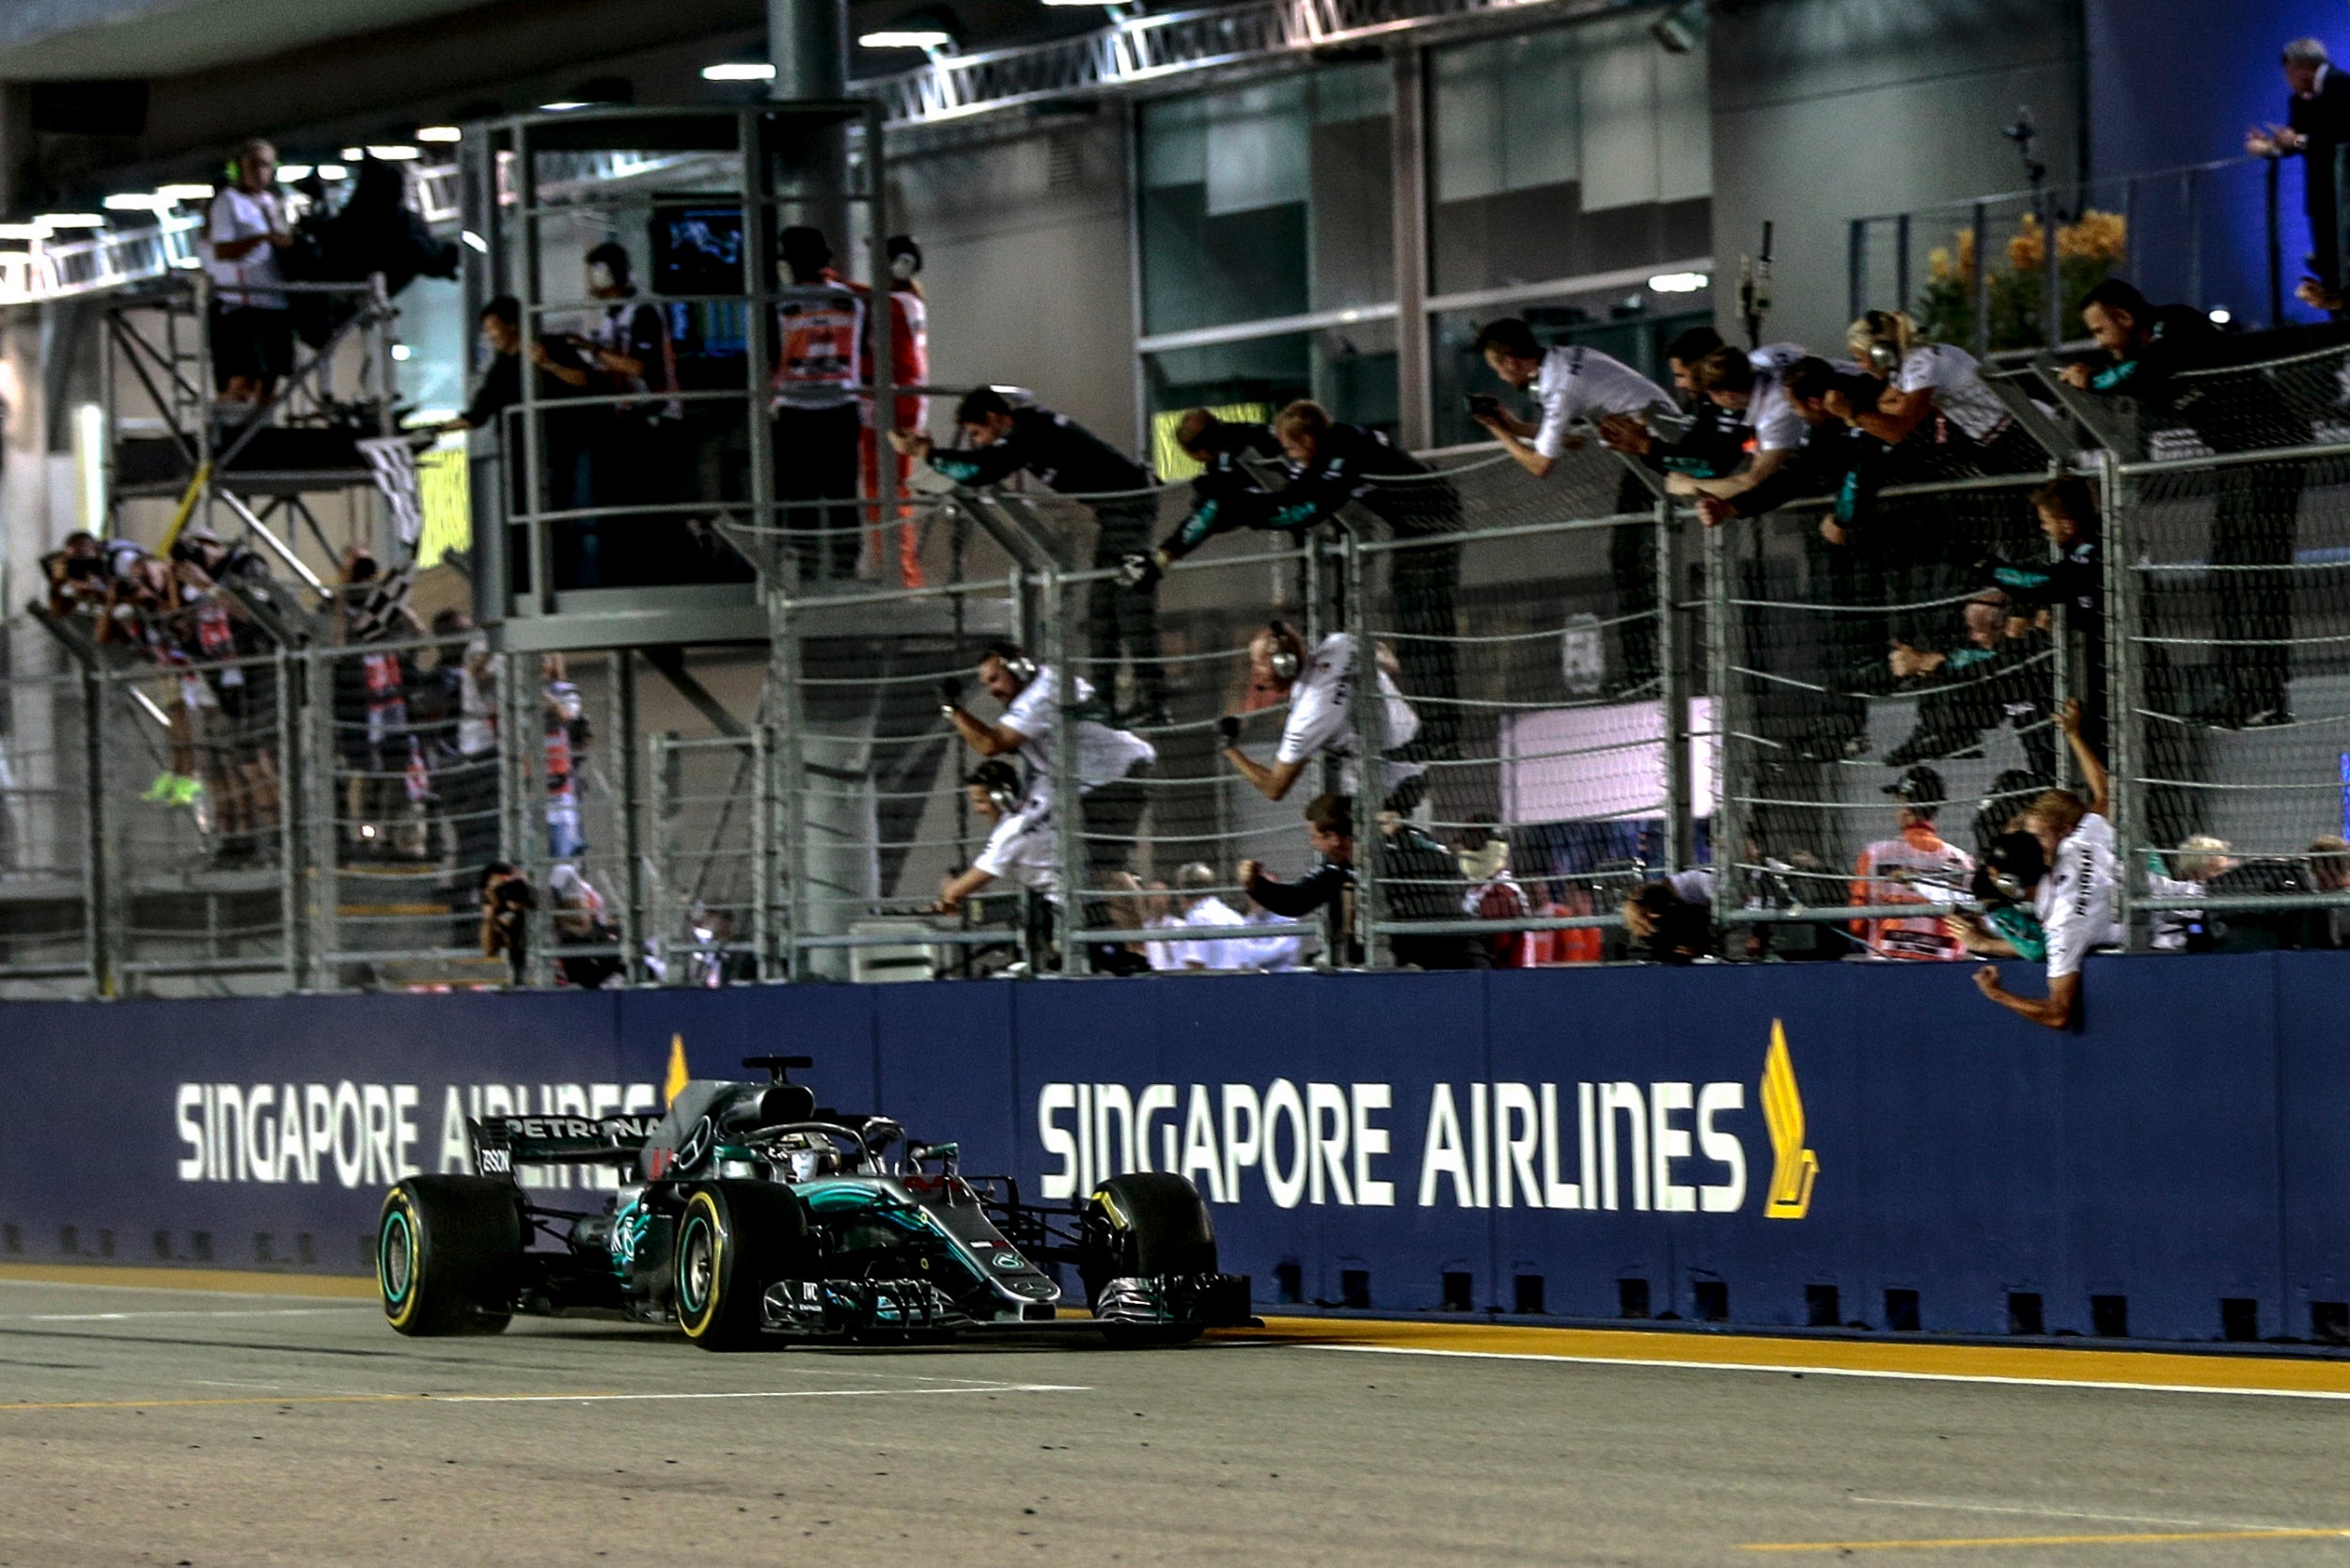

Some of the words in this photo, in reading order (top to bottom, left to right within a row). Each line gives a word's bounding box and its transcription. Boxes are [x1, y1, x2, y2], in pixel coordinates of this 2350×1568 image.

[176, 1079, 420, 1188] SINGAPORE
[506, 1117, 663, 1139] PETRNA
[1038, 1078, 1395, 1209] SINGAPORE
[1418, 1081, 1747, 1213] AIRLINES
